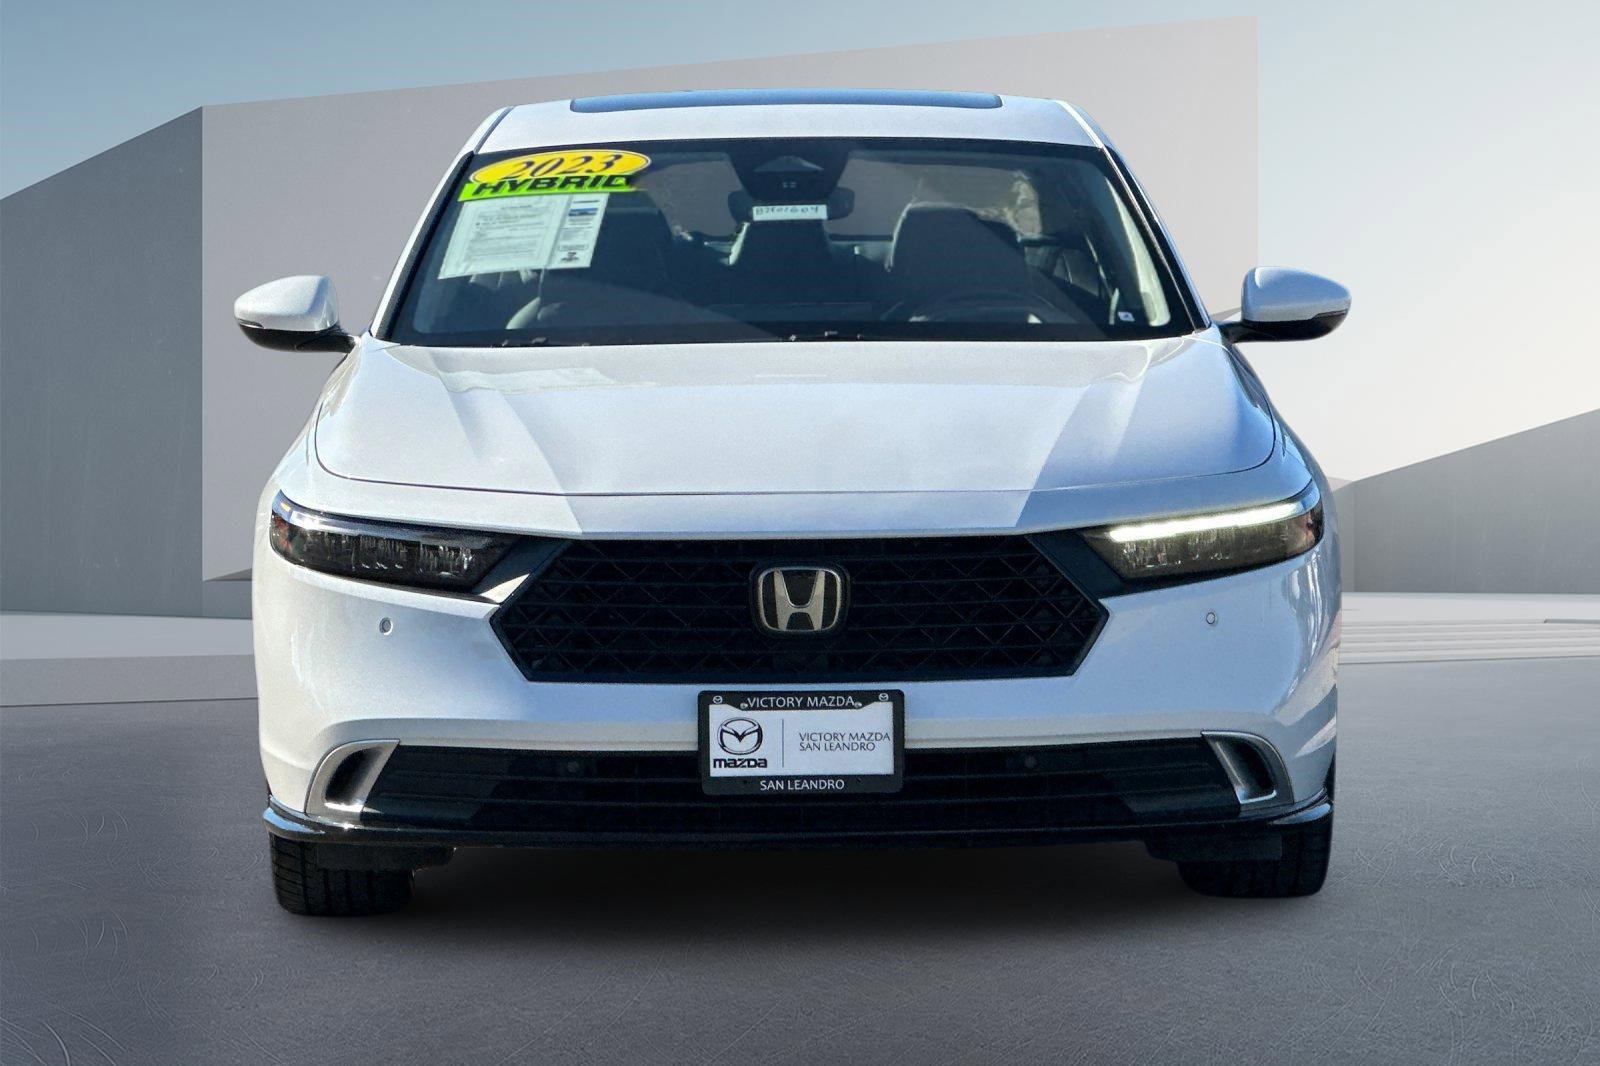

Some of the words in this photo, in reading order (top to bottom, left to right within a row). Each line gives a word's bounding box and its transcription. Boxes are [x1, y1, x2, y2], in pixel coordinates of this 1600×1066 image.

[500, 154, 623, 180] 2023
[747, 697, 803, 708] VICTORY
[807, 696, 855, 707] MAZDA
[799, 732, 845, 742] VICTORY
[847, 732, 890, 742] MAZDA
[799, 742, 821, 751] SAN
[824, 742, 875, 751] LEANDRO
[760, 780, 784, 791] SAN
[788, 780, 845, 790] LEANDRO
